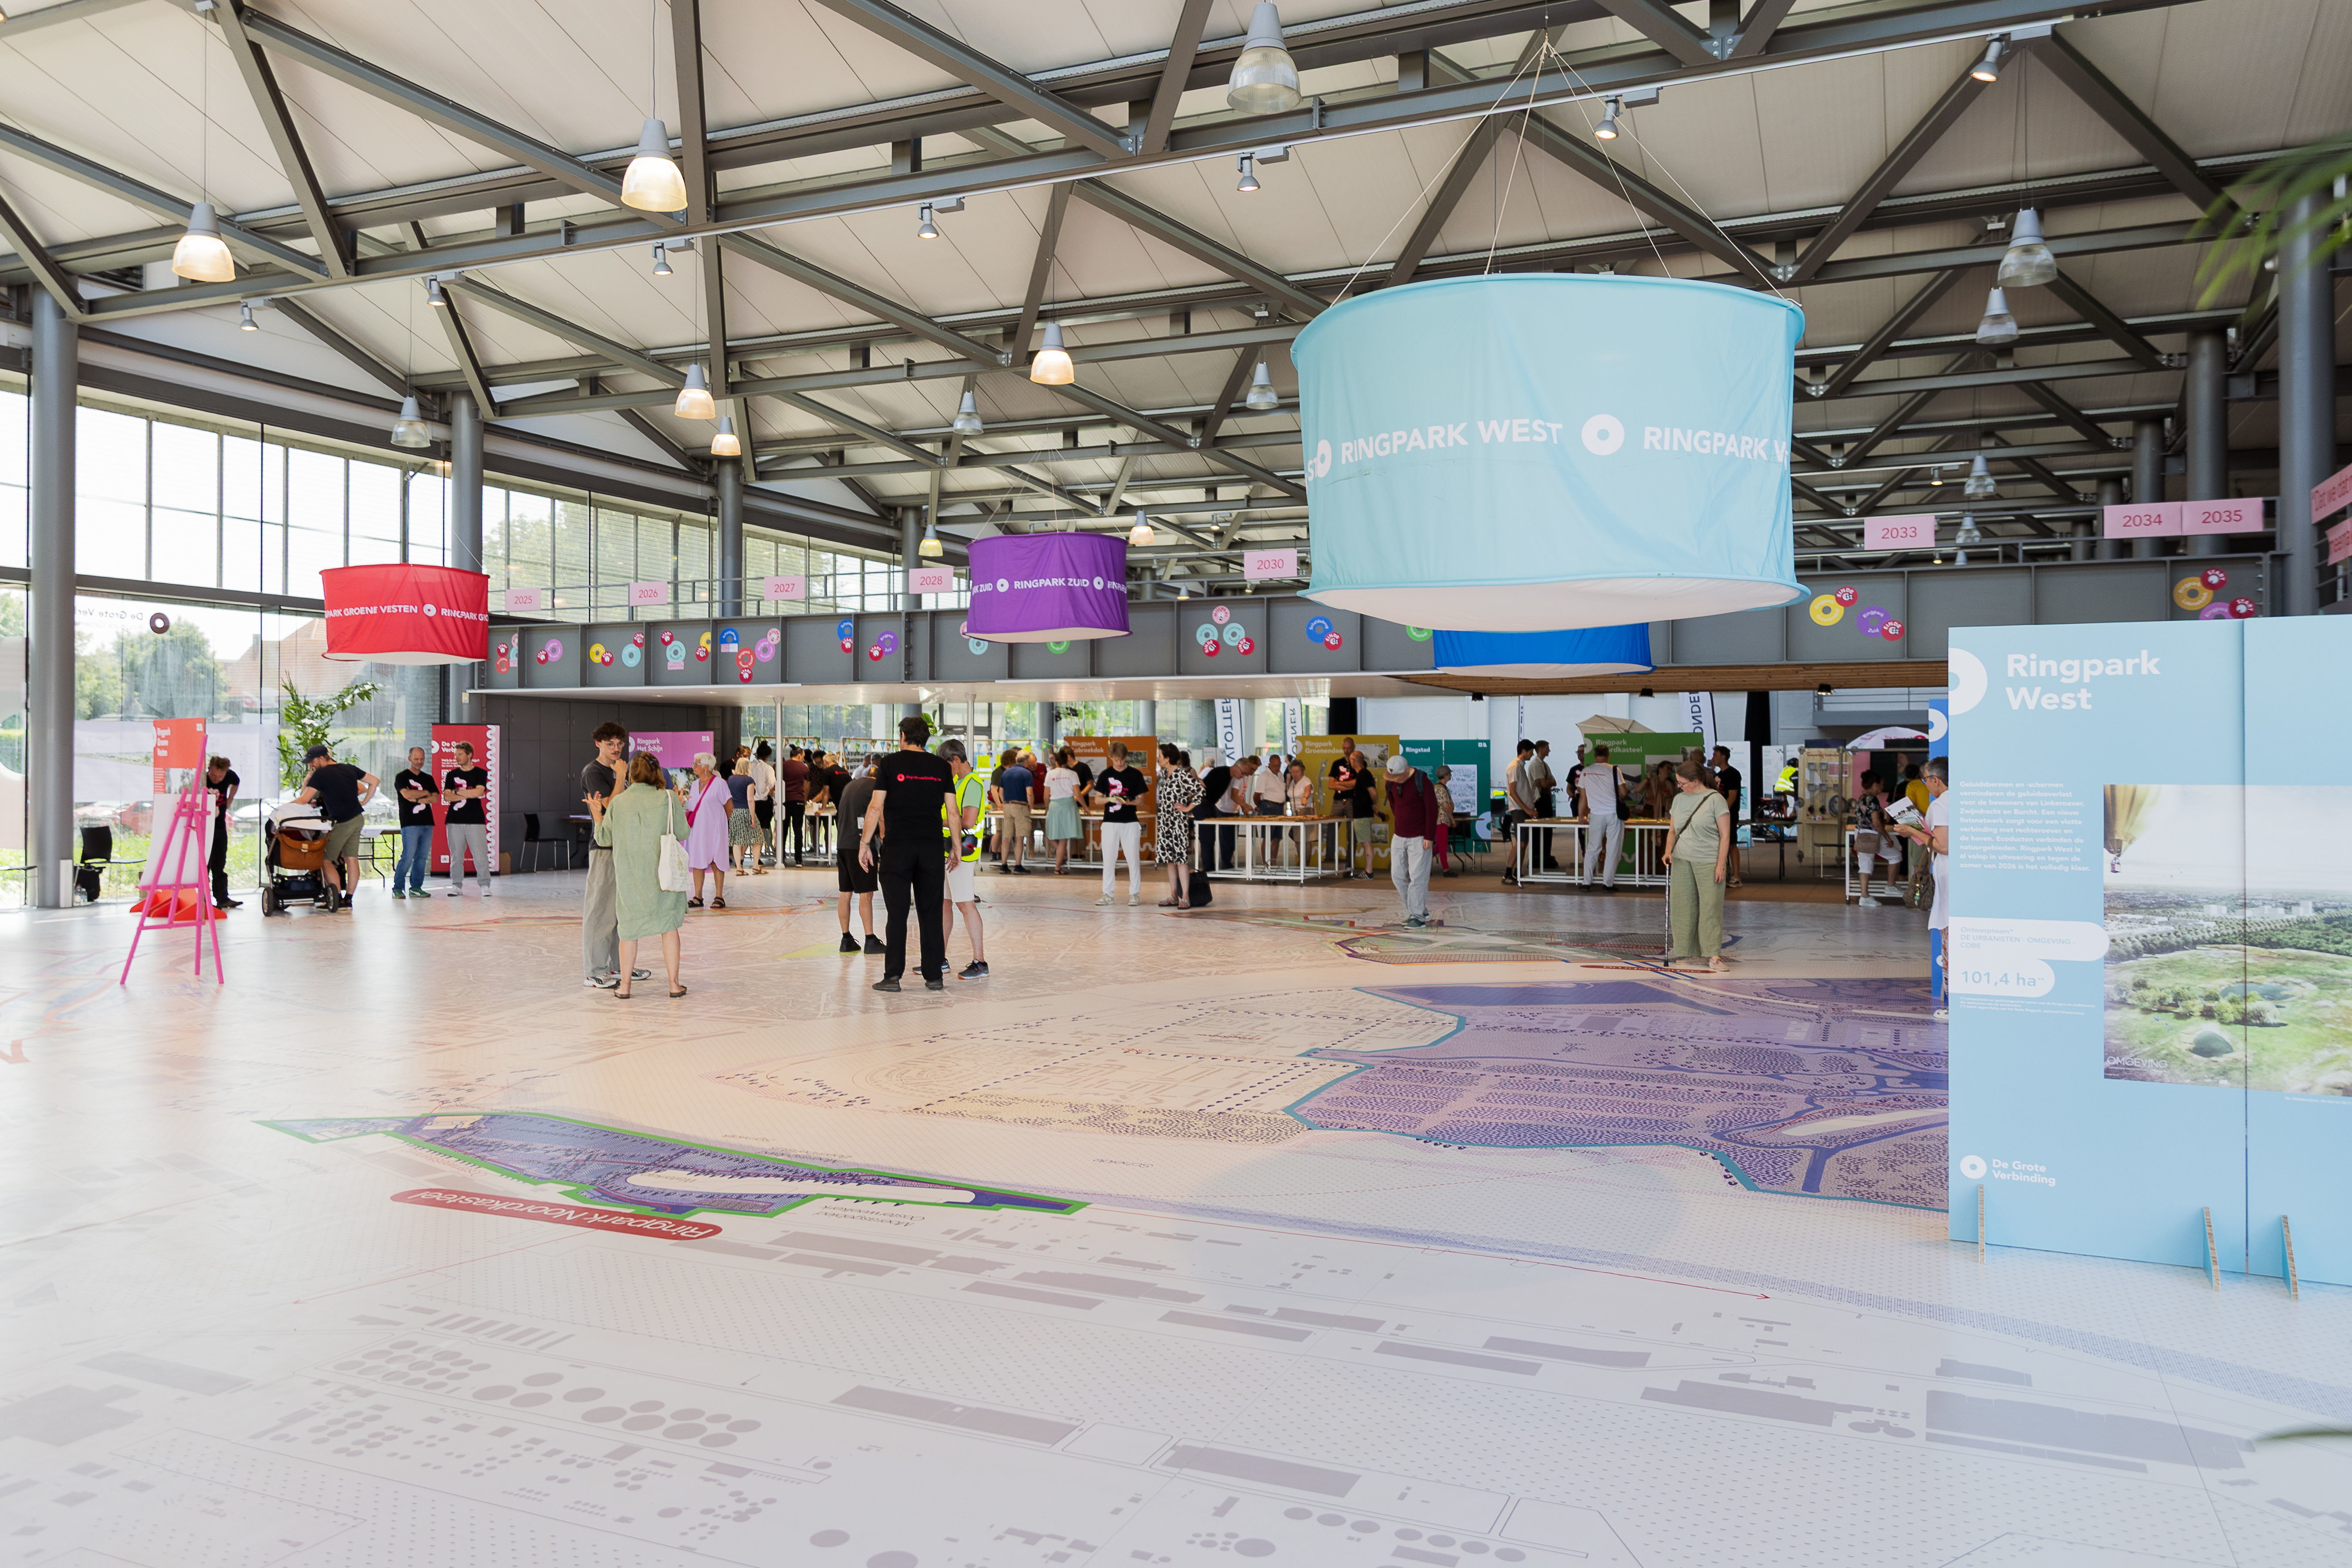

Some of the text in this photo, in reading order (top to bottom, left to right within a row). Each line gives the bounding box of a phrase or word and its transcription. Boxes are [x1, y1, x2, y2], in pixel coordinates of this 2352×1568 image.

[1341, 419, 1564, 465] RINGPARK WEST
[1643, 426, 1768, 460] RINGPARK
[2122, 514, 2163, 527] 2034
[2201, 510, 2243, 524] 2035
[1881, 525, 1917, 540] 2033
[1257, 558, 1284, 570] 2030
[920, 575, 943, 586] 2028
[2207, 569, 2226, 581] START
[774, 583, 795, 593] 2027
[979, 582, 993, 592] ZUID
[1014, 578, 1089, 590] RINGPARK ZUID
[638, 588, 659, 598] 2026
[1837, 588, 1854, 598] EINDE
[514, 595, 533, 605] 2025
[2236, 599, 2254, 612] START
[343, 606, 378, 616] GROENE
[380, 605, 418, 613] VESTEN
[440, 608, 477, 621] RINGPARK
[1862, 610, 1885, 618] Ringpark
[1309, 619, 1329, 631] Scheldebrug
[1883, 622, 1902, 631] EINDE
[1325, 633, 1340, 642] EINDE
[1204, 640, 1213, 653] EINDE
[1238, 638, 1247, 653] EINDE
[2006, 650, 2161, 683] Ringpark
[2005, 687, 2092, 710] West
[637, 737, 660, 746] Ringpark
[1305, 740, 1333, 748] Ringpark
[1595, 738, 1627, 747] Ringpark
[2040, 863, 2069, 872] volledig
[1961, 971, 2010, 987] 101,4
[2106, 1056, 2168, 1068] OMGEVING
[1992, 1159, 2047, 1173] De Grote
[1992, 1169, 2056, 1187] Verbinding
[407, 1191, 714, 1239] Ringpark Noordkasteel
